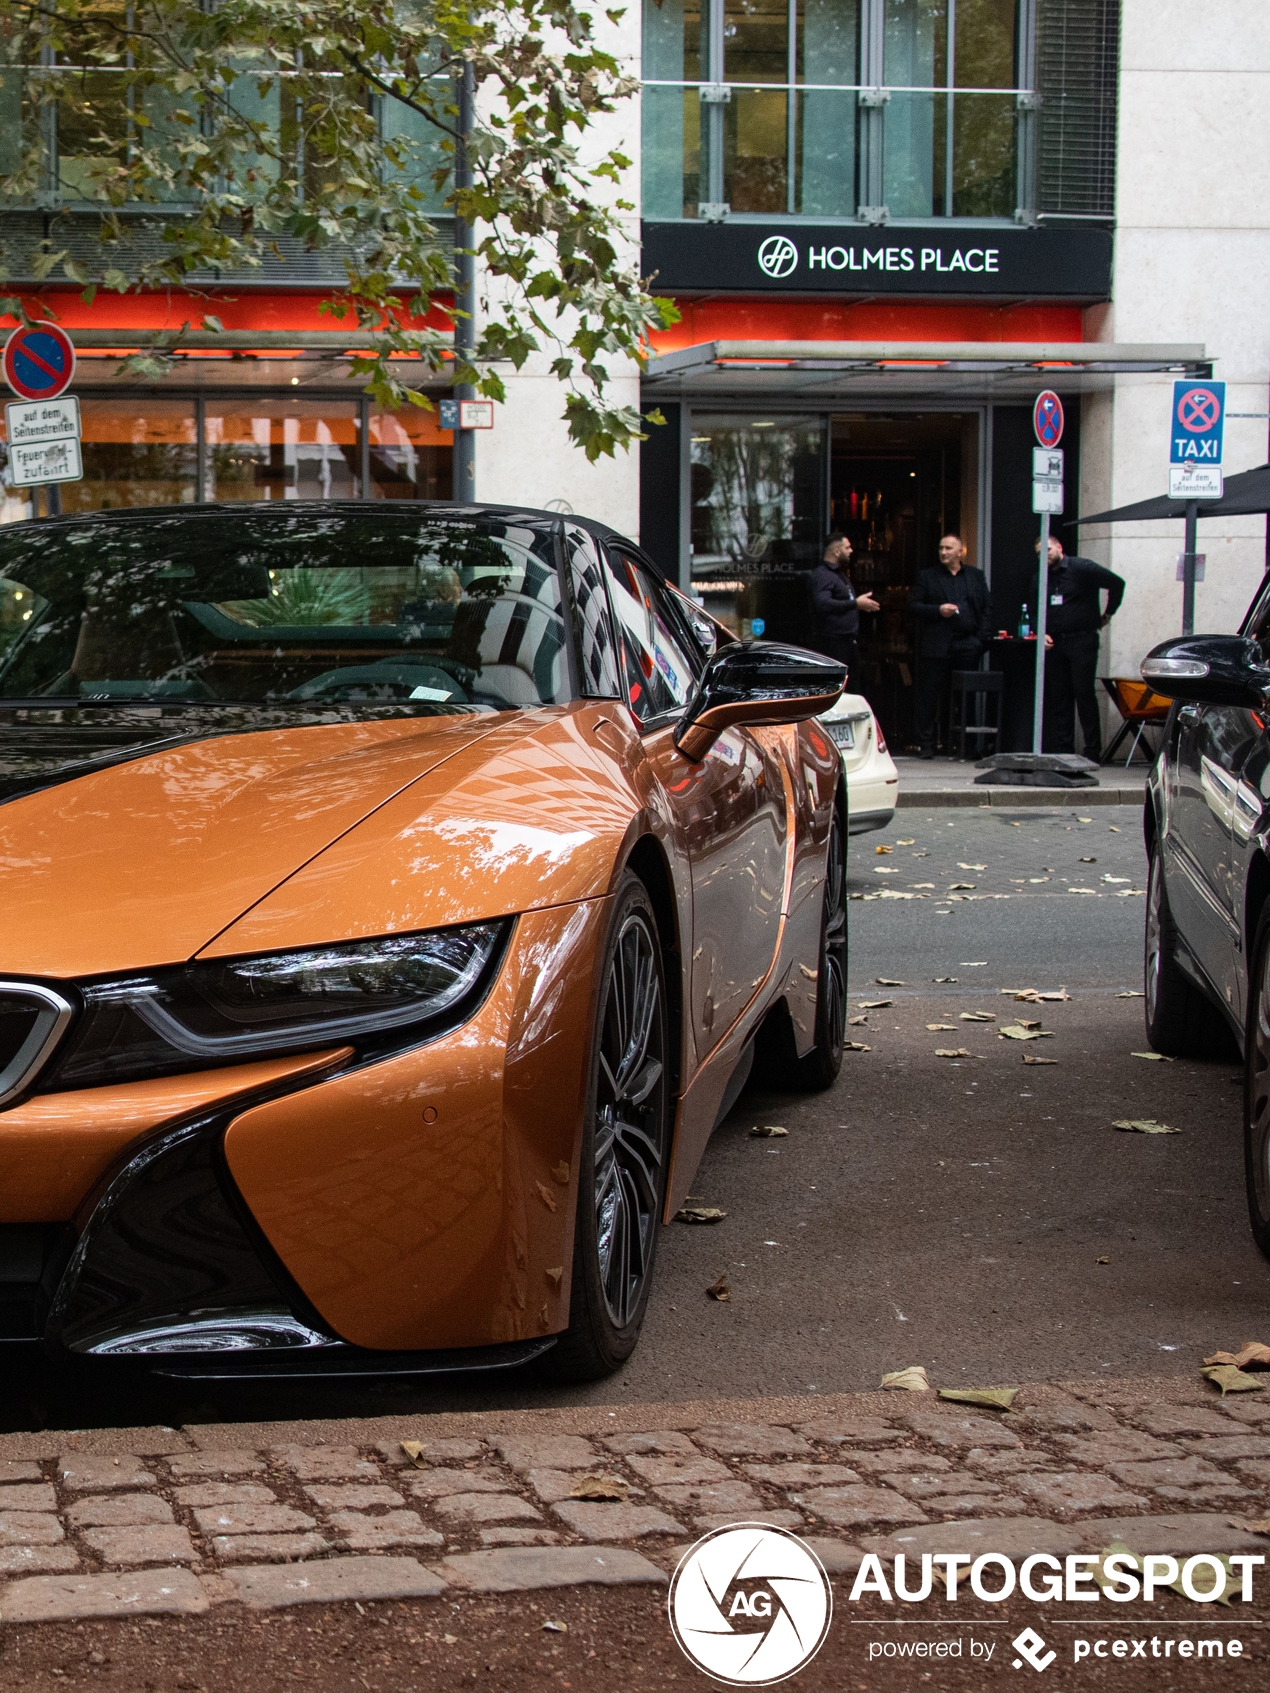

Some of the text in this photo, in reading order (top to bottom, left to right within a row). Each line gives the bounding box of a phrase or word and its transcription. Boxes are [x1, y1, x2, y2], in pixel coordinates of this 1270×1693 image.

[809, 246, 999, 272] HOLMES PLACE
[24, 408, 61, 422] auf dem
[13, 422, 75, 438] Seitenstreifen
[1174, 439, 1218, 457] TAXI
[1182, 472, 1193, 482] auf
[1173, 483, 1219, 492] Seitenstreifen
